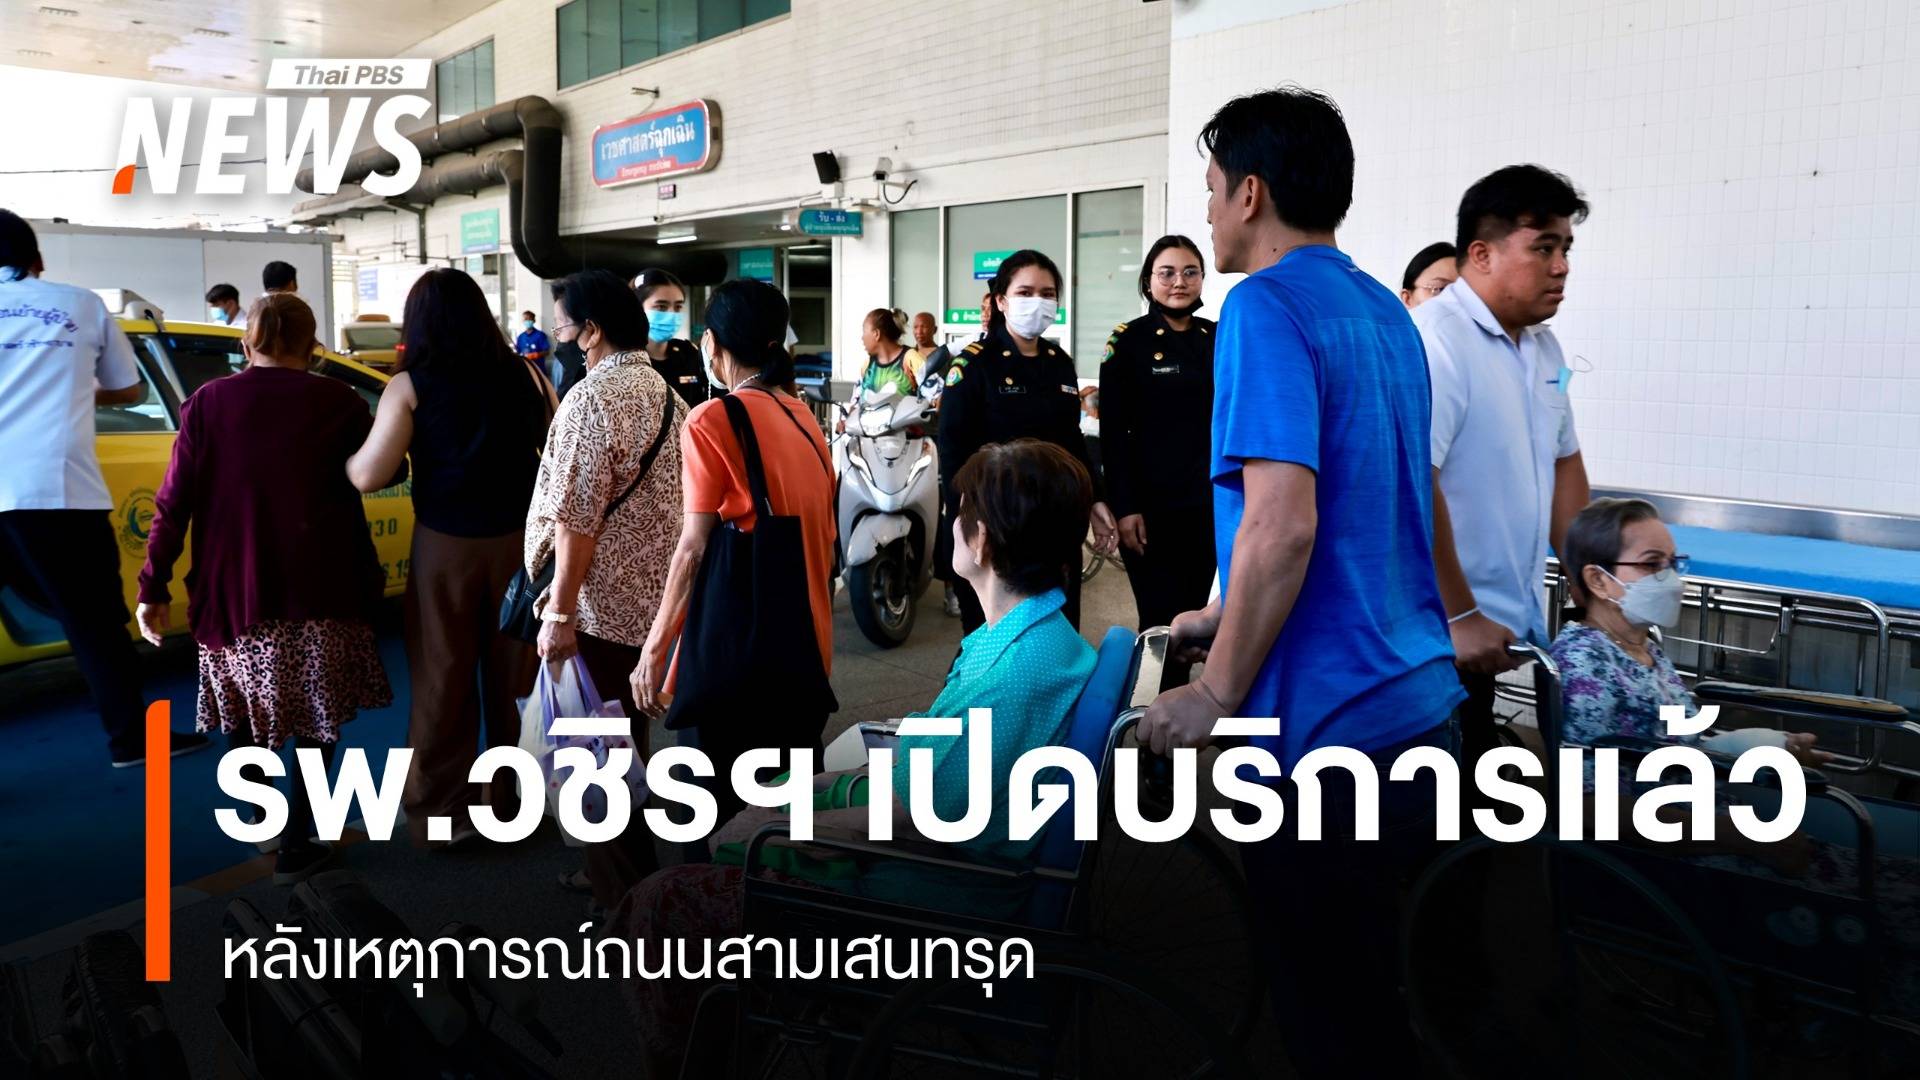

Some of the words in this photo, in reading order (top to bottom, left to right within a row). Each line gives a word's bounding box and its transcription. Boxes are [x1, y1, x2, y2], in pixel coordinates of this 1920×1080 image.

[601, 114, 696, 160] เวชศาสตร์ฉุกเฉิน
